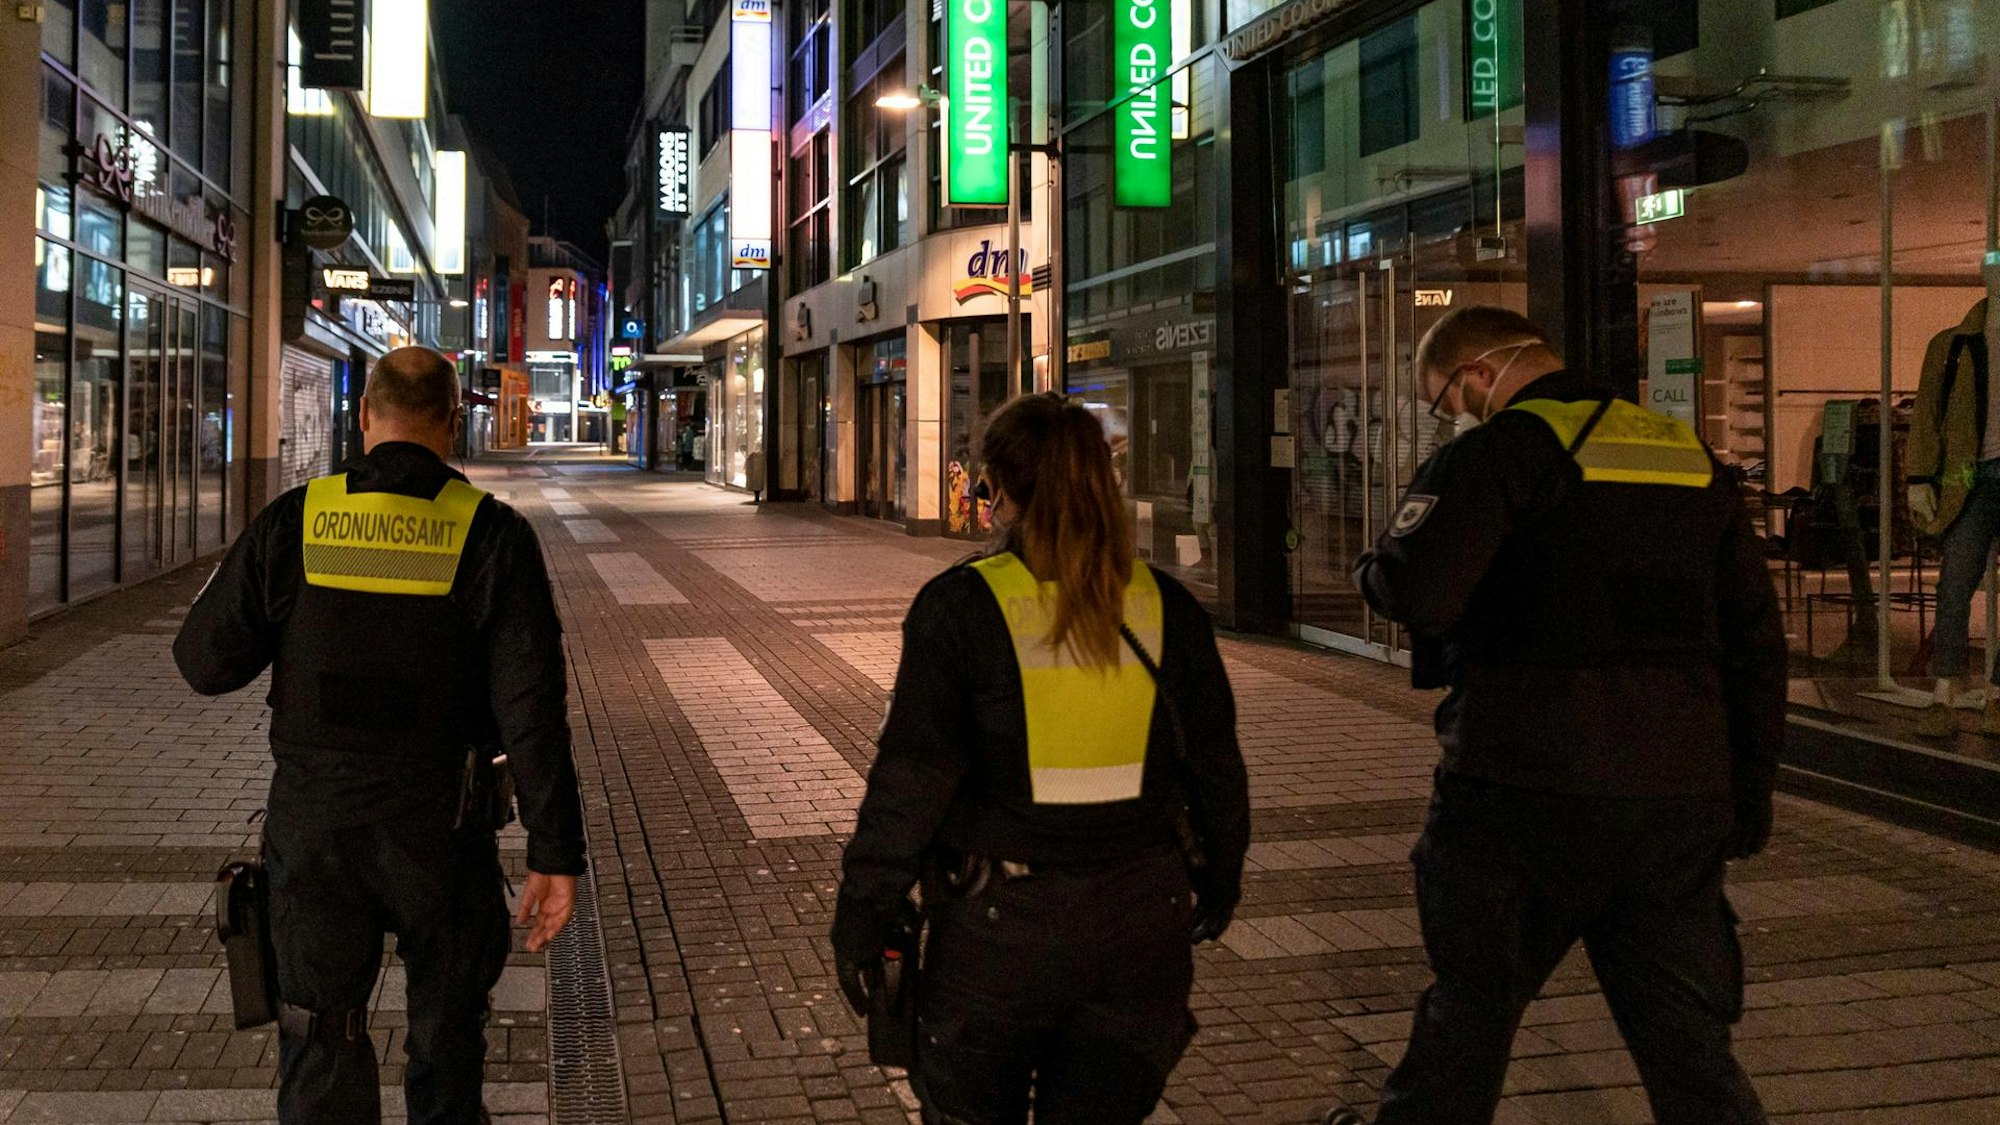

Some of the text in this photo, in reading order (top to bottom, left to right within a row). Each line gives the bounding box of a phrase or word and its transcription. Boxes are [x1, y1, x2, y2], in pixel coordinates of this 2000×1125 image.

[1226, 18, 1276, 60] UNITED
[964, 37, 992, 155] UNITED
[659, 131, 675, 212] MAISONS
[740, 243, 765, 258] dm
[967, 239, 1026, 277] dm
[323, 268, 369, 290] VANS
[1652, 389, 1689, 403] CALL
[313, 511, 457, 548] ORDNUNGSAMT
